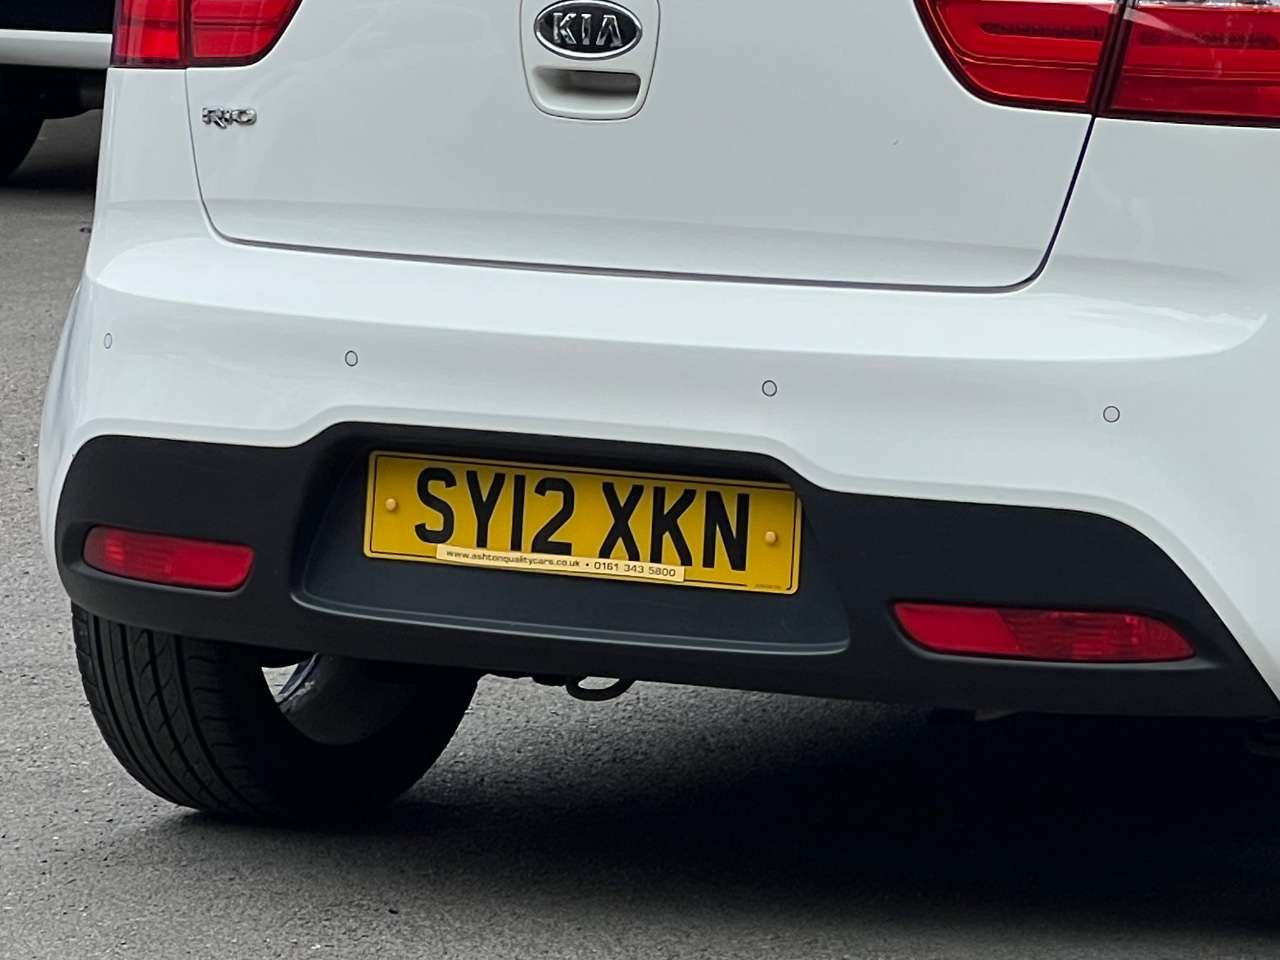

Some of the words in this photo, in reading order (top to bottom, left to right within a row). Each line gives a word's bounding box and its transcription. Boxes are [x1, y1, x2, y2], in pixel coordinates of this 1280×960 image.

[552, 12, 624, 47] KIA
[413, 466, 576, 556] SY12
[597, 480, 751, 572] XKN
[446, 549, 580, 568] www.ashtonqualitycars.co.uk
[593, 561, 620, 572] 0161
[623, 563, 645, 574] 343
[648, 566, 676, 577] 5800
